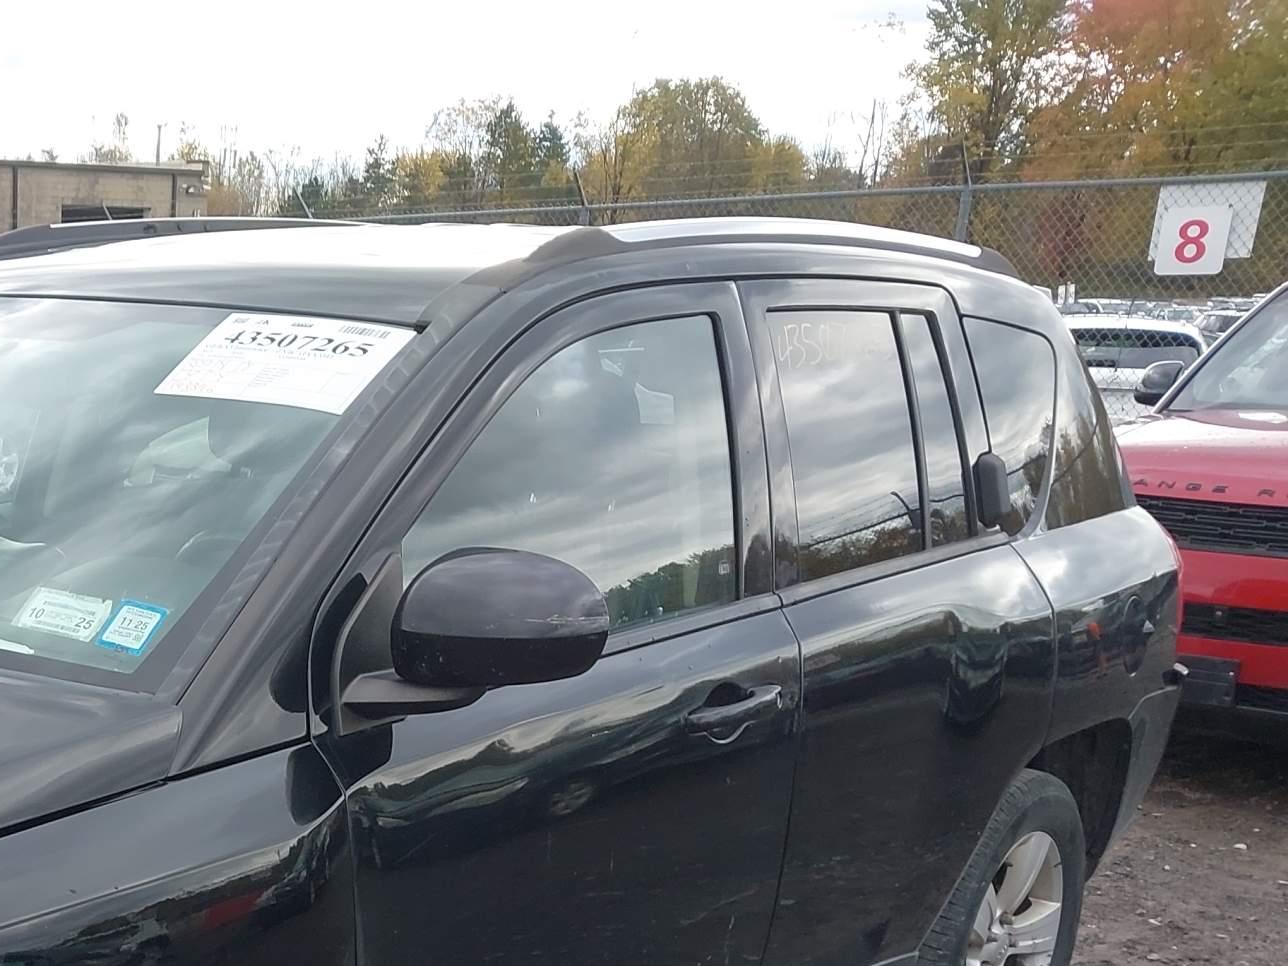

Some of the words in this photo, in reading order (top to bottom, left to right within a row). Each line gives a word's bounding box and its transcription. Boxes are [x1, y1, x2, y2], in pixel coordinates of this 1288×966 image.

[1173, 218, 1211, 264] 8
[224, 329, 376, 358] 43507265
[1132, 478, 1229, 495] ANGE
[29, 606, 45, 620] 10
[75, 616, 95, 631] 25
[120, 615, 132, 628] 11
[134, 619, 149, 631] 25
